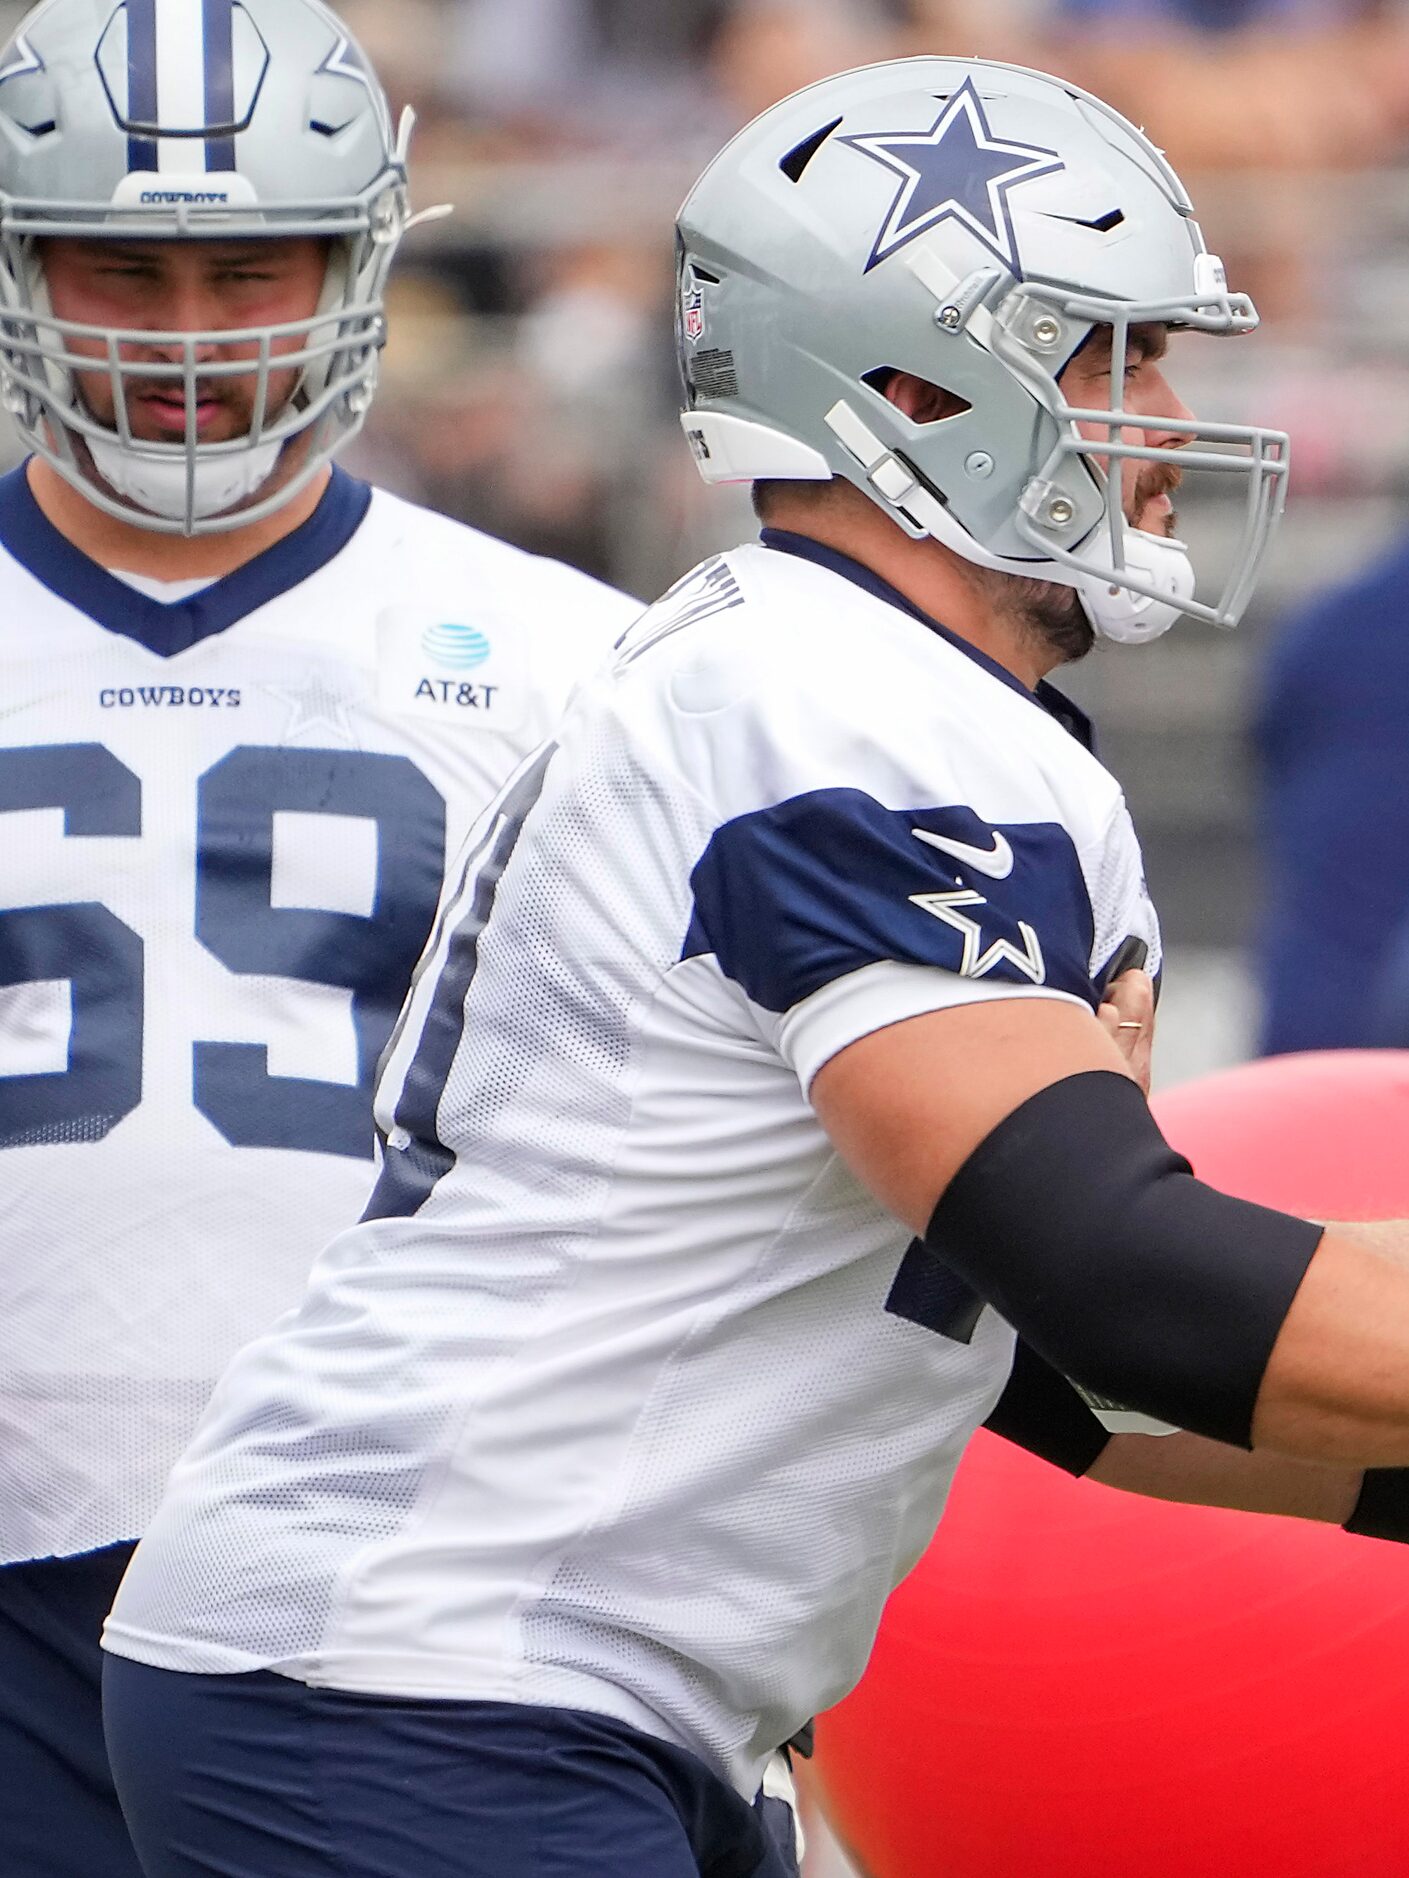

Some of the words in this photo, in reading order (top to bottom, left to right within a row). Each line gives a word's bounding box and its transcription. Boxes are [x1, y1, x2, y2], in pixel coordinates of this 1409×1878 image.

[100, 686, 241, 708] COWBOYS
[415, 678, 499, 710] AT&T
[0, 742, 446, 1161] 69
